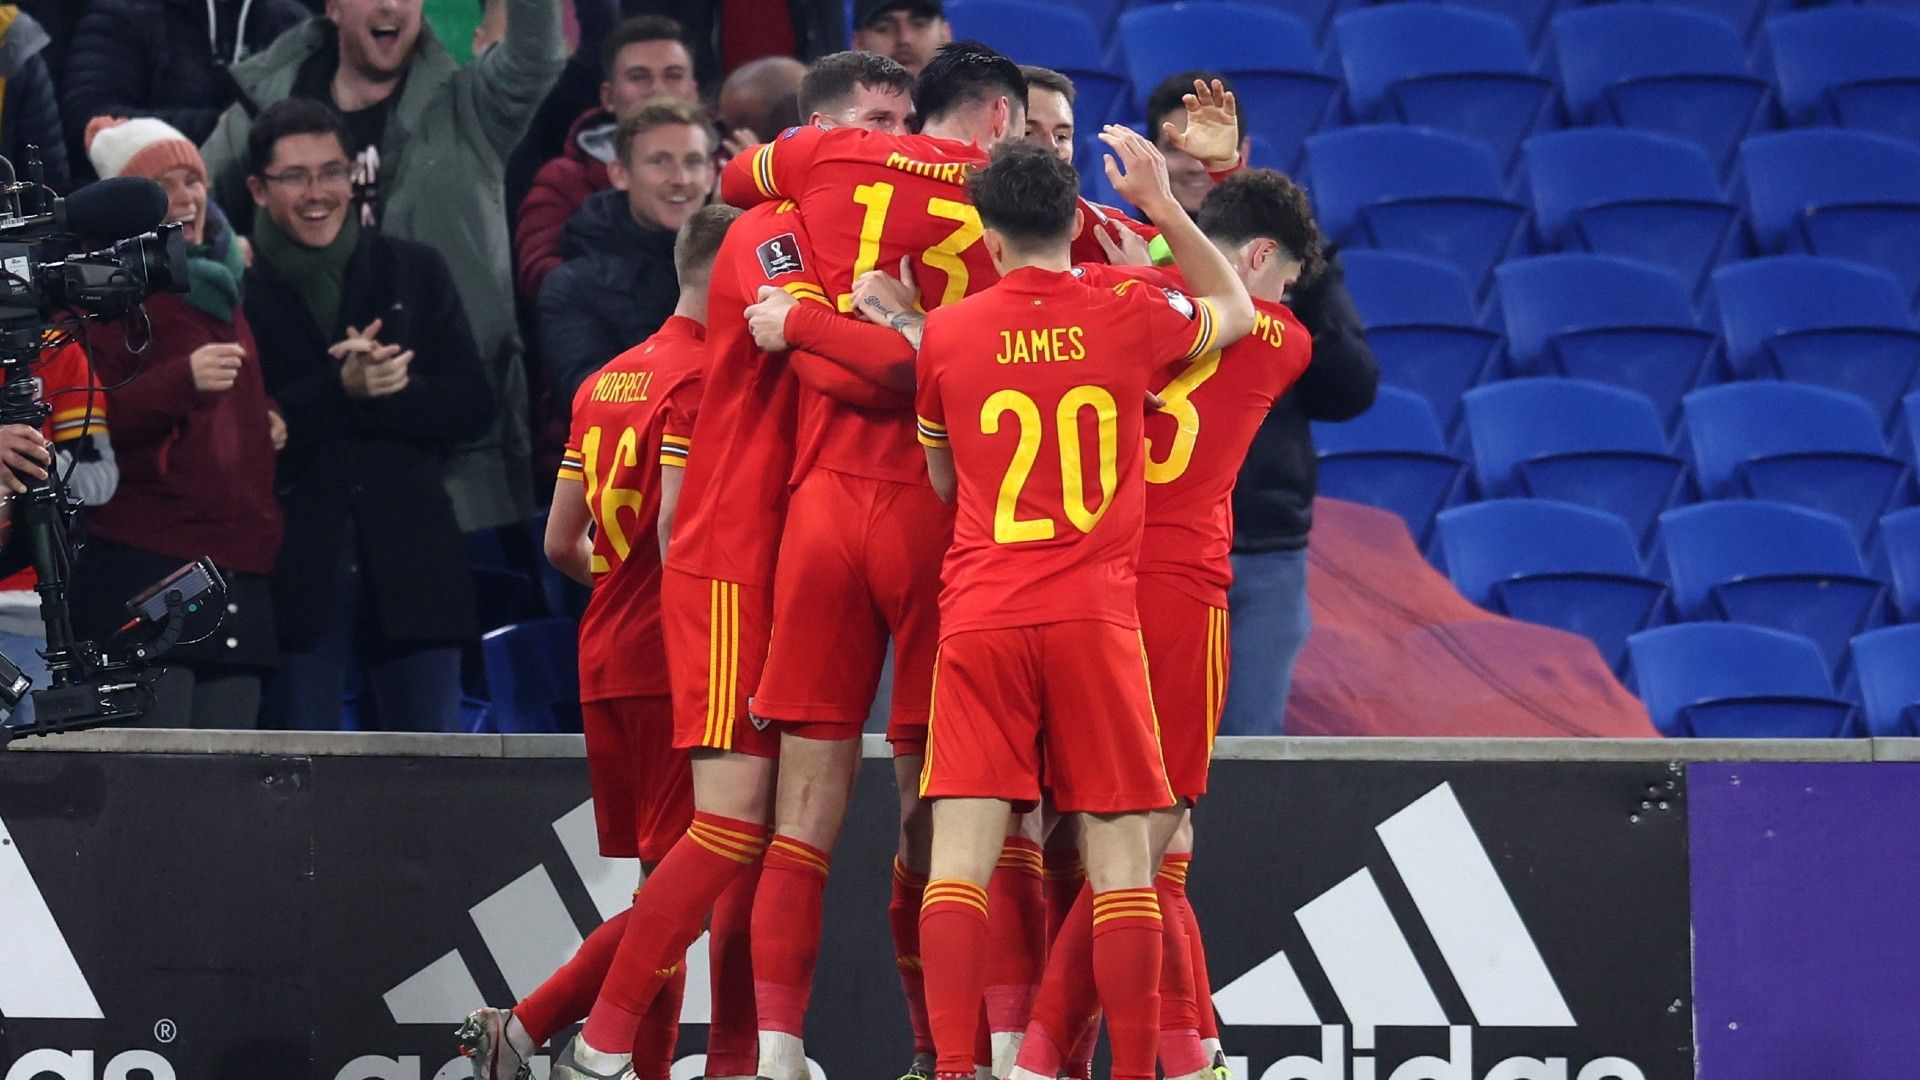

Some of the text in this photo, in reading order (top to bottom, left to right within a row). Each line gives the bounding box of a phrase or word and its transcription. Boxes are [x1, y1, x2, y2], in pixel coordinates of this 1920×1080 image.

[838, 181, 985, 313] 13
[996, 327, 1086, 364] JAMES
[1252, 310, 1286, 348] MS
[590, 371, 653, 402] MORRELL
[581, 426, 643, 573] 16
[980, 385, 1117, 544] 20
